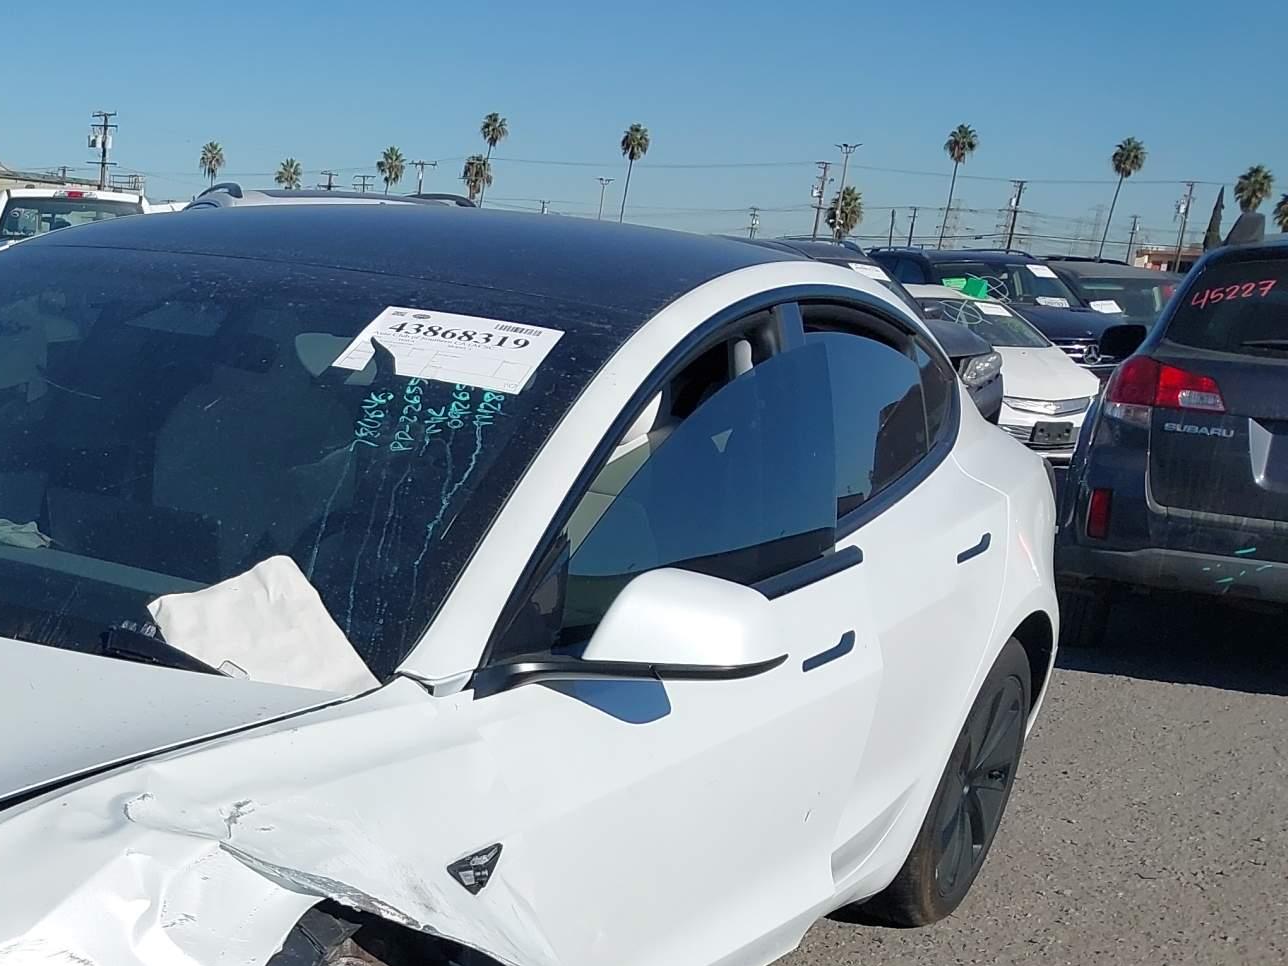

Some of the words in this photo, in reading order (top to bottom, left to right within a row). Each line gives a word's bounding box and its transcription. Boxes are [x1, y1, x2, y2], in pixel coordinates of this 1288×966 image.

[1191, 279, 1277, 309] 45227
[389, 322, 531, 350] 43868319
[1164, 422, 1235, 438] SUBARU
